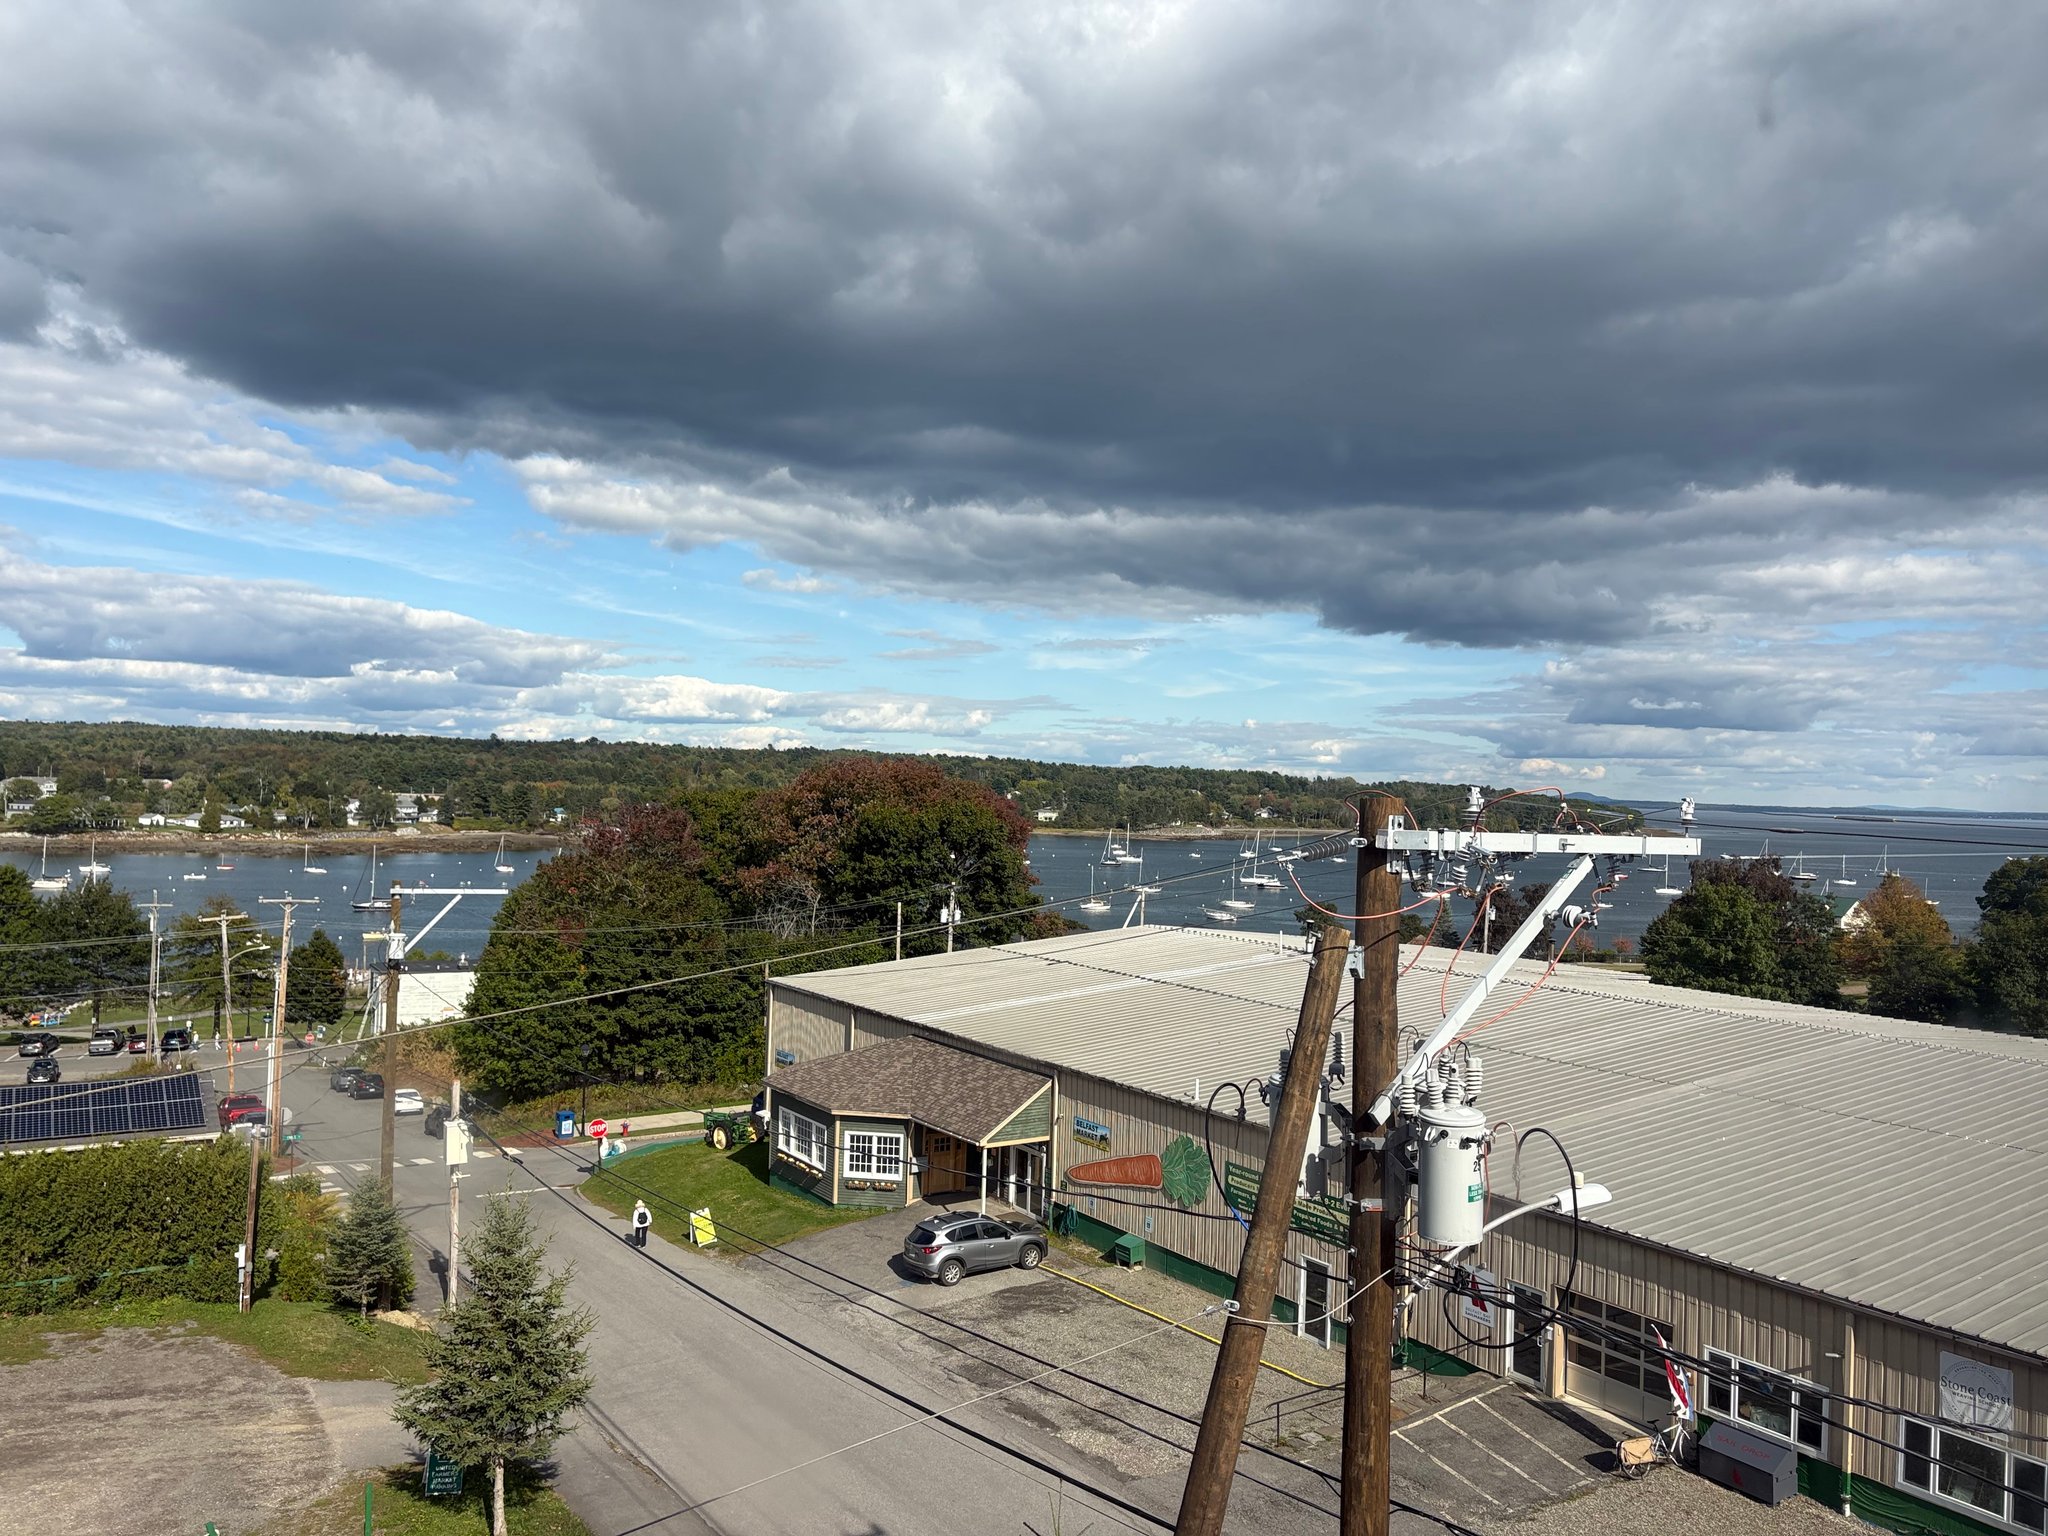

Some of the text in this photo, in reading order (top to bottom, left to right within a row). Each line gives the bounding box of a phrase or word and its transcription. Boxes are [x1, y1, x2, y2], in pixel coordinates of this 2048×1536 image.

[589, 1123, 606, 1133] STOP
[1076, 1120, 1098, 1133] BELFAST
[1076, 1128, 1098, 1141] MARKET
[1229, 1165, 1259, 1181] Year-round
[1231, 1177, 1256, 1191] Producers
[1317, 1217, 1333, 1229] Foods
[1941, 1376, 2011, 1406] Stone Coast
[1952, 1391, 2000, 1409] WEAVING SCHOOL
